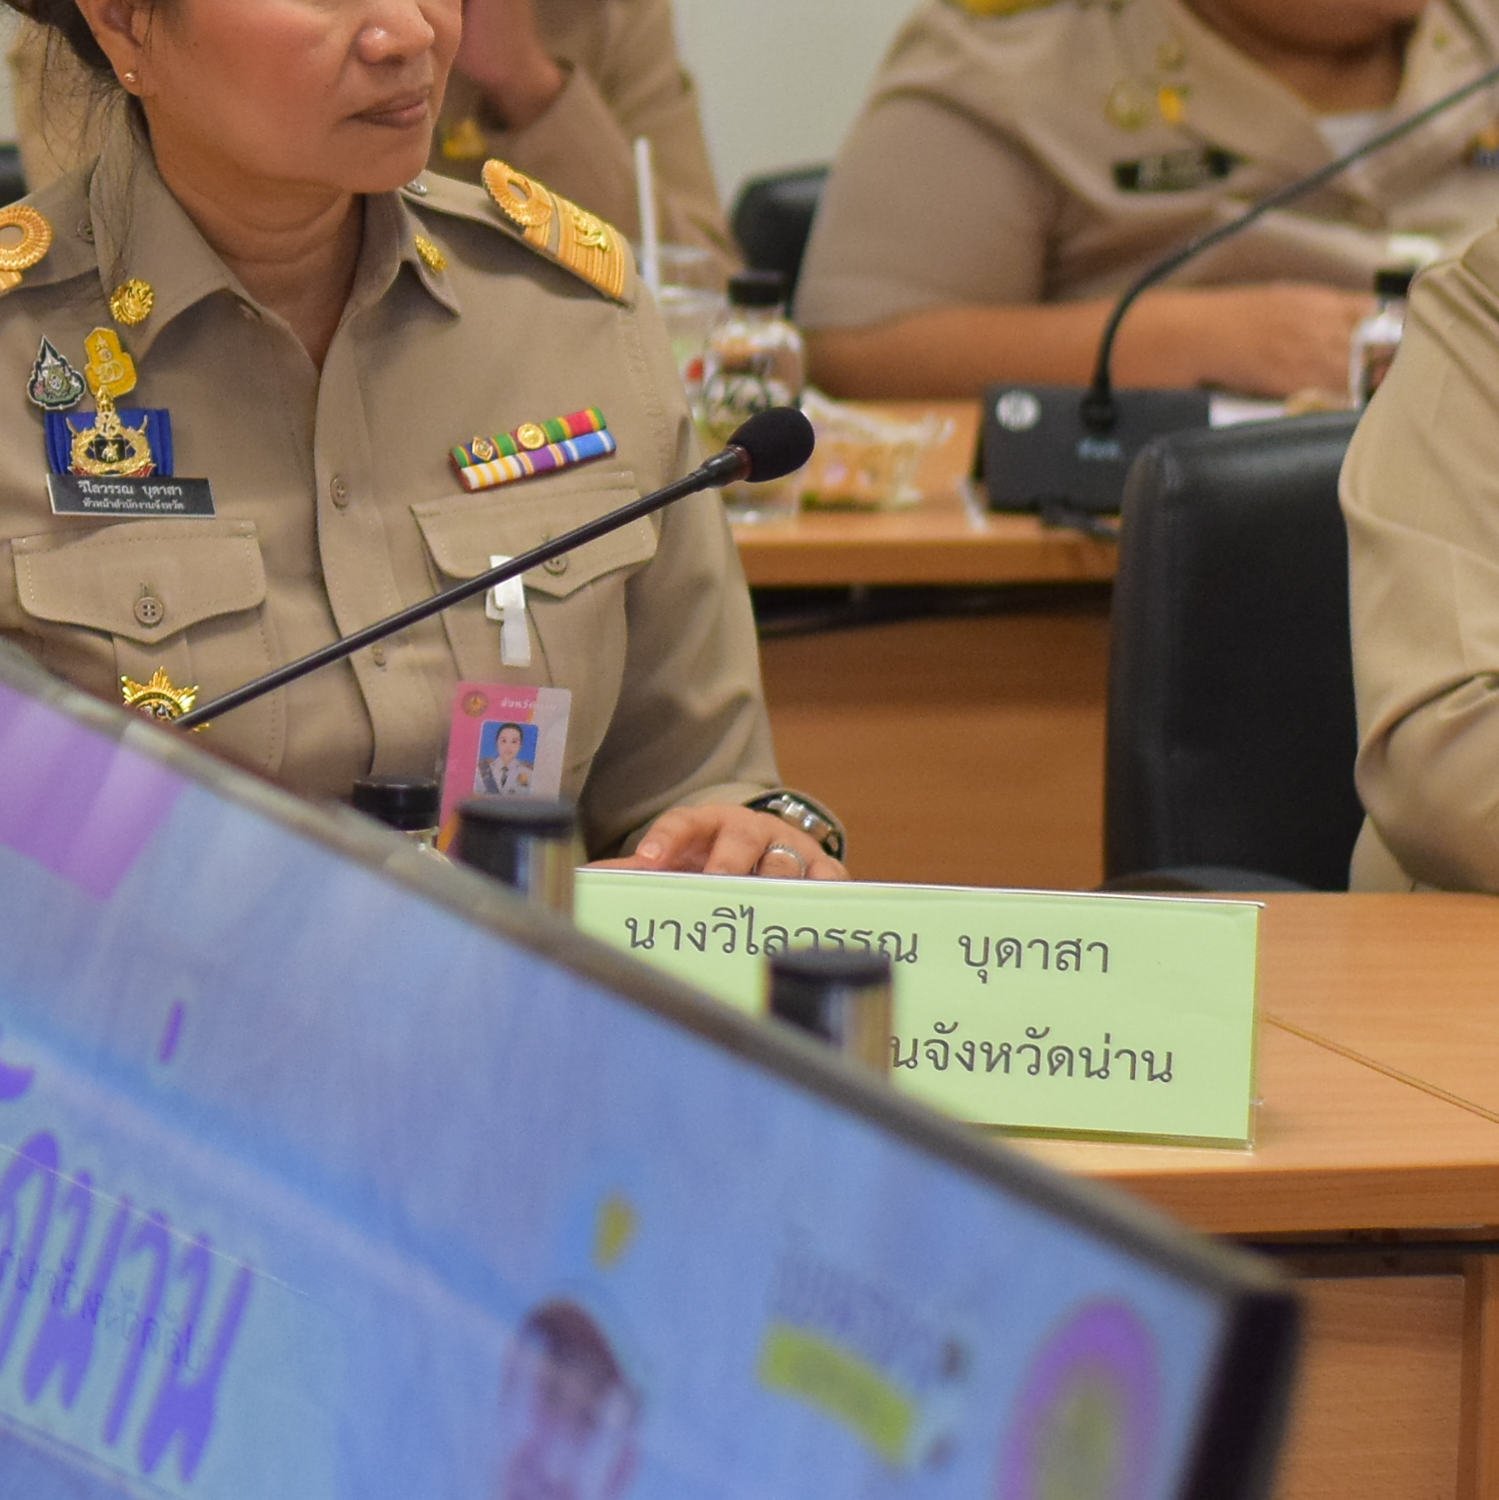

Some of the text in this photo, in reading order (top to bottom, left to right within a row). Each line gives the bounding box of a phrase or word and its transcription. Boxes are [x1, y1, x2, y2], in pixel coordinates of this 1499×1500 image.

[625, 904, 1110, 984] นางวิไลวรรณ บุดาสา
